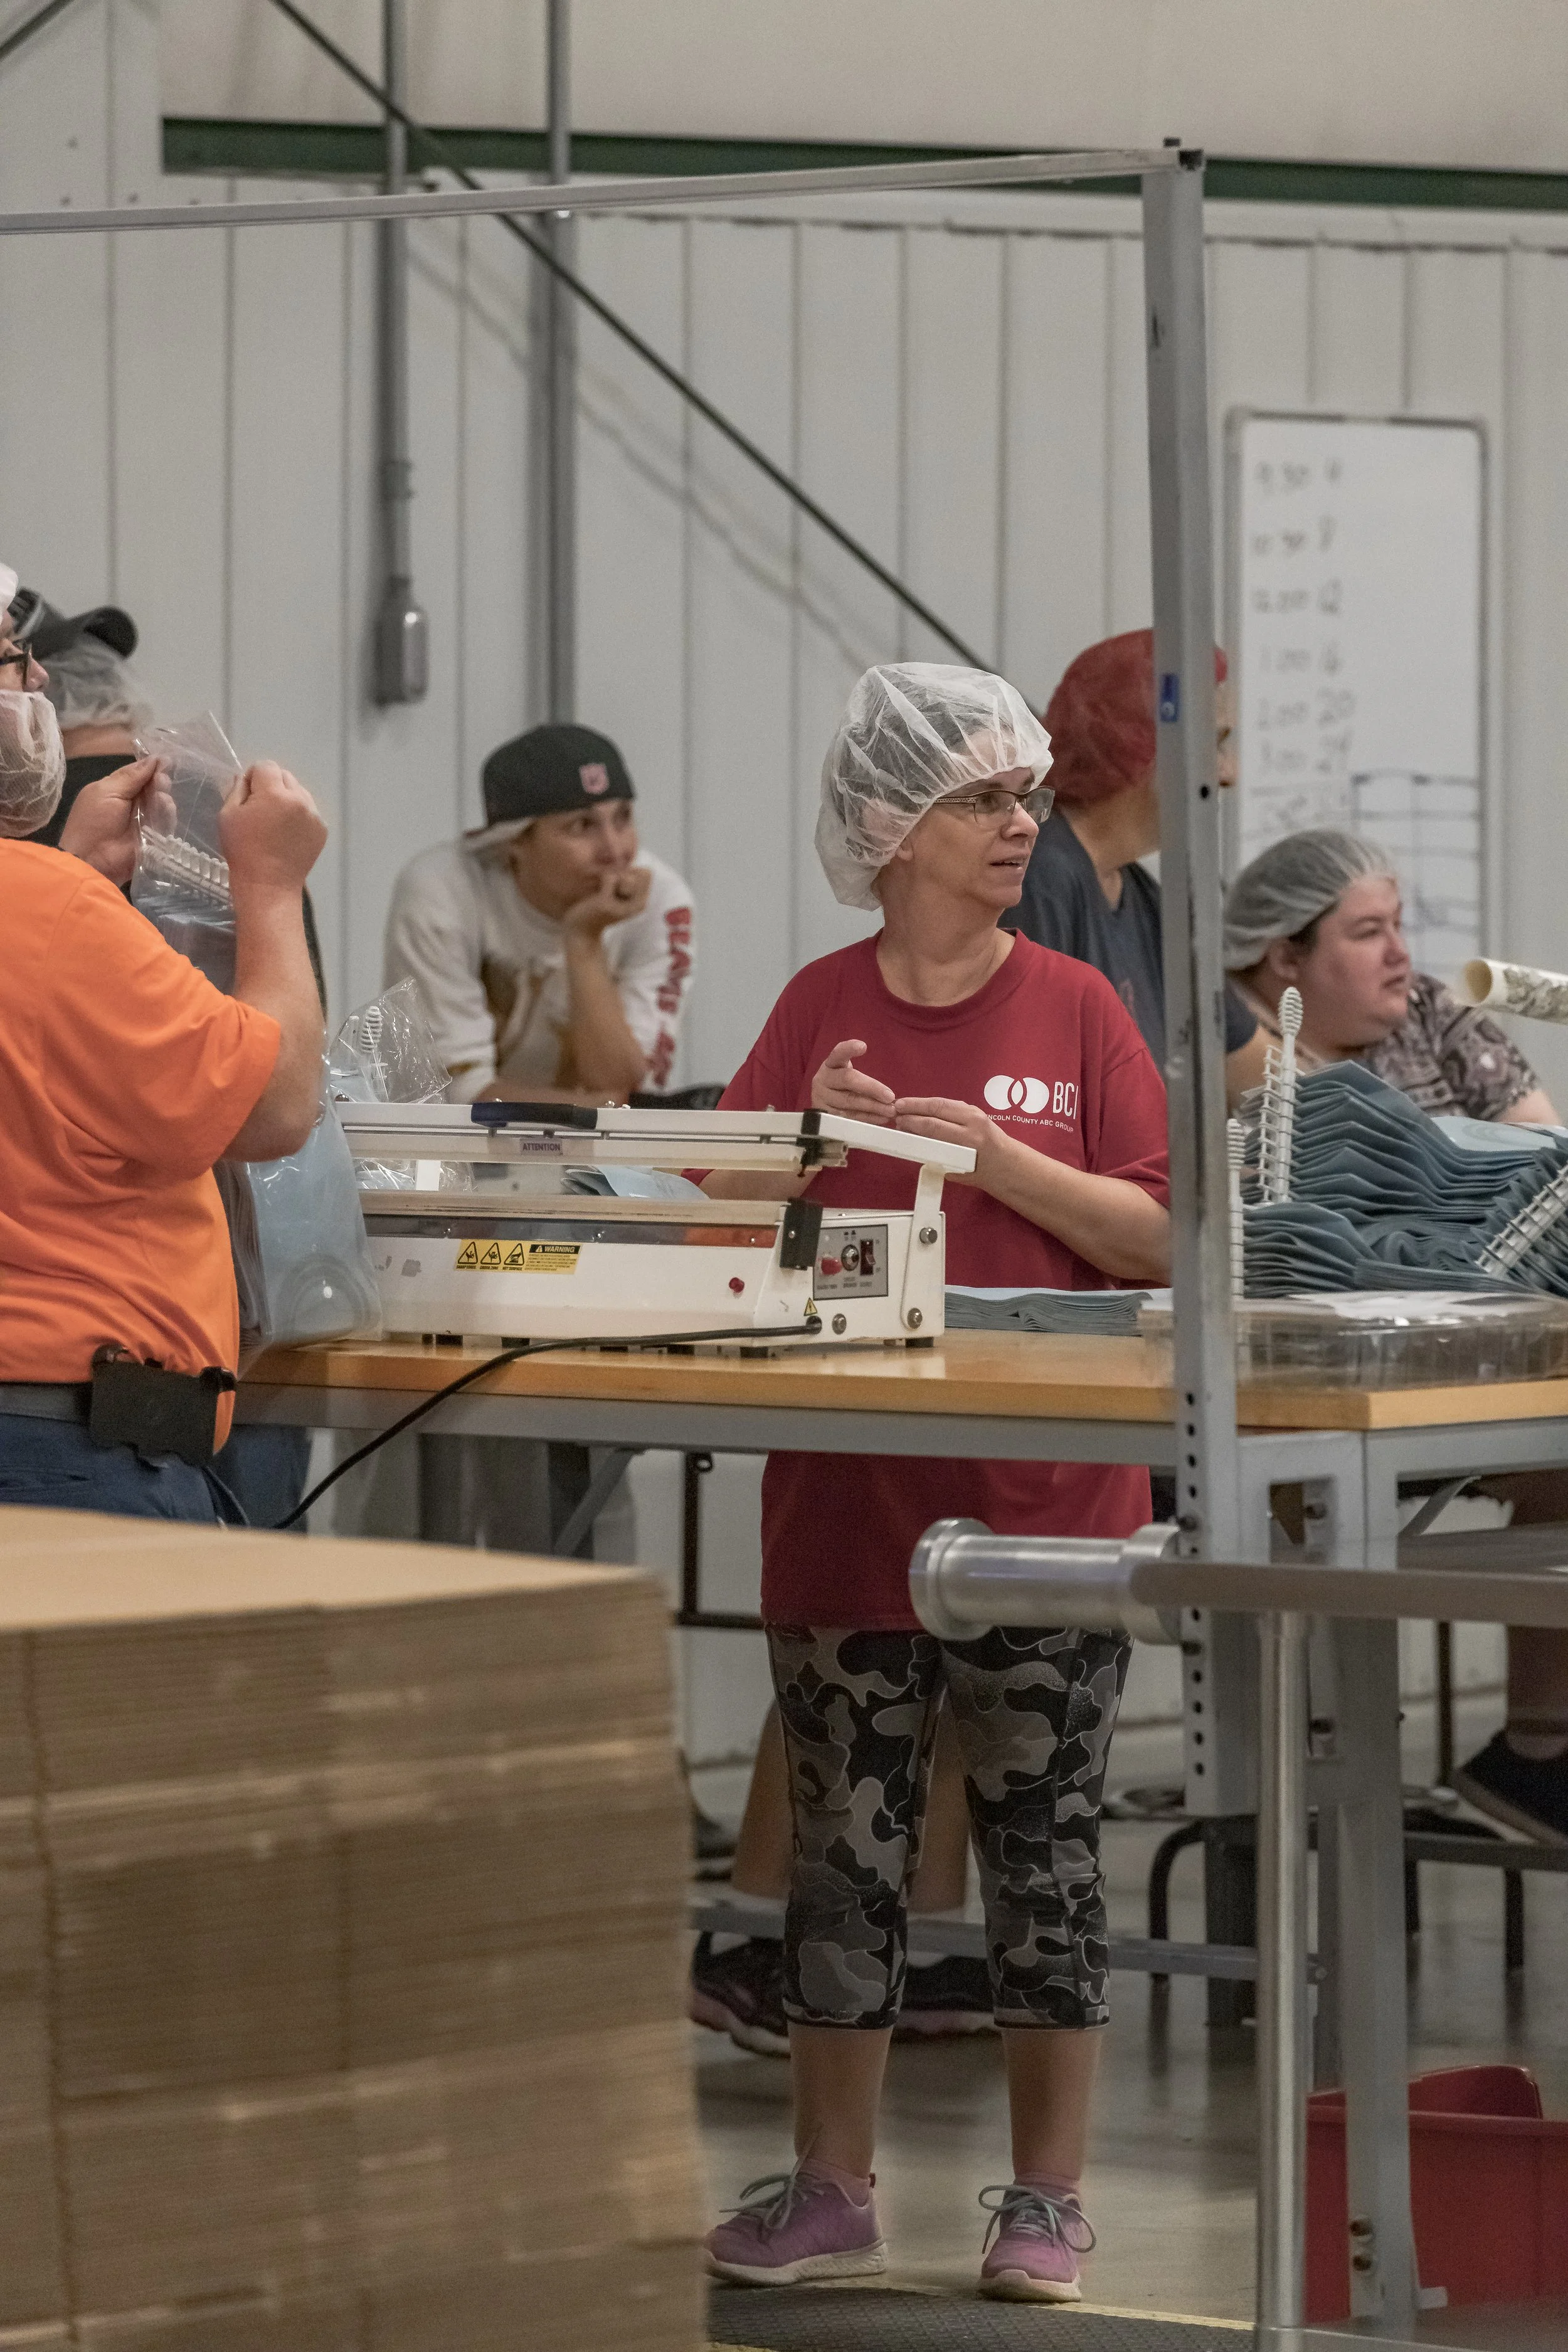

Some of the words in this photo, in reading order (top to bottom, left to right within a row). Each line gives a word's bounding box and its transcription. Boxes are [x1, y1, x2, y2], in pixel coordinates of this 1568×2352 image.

[1012, 1115, 1039, 1125] COUNTY
[1055, 1121, 1074, 1133] GROUP
[522, 1143, 561, 1152] ATTENTION
